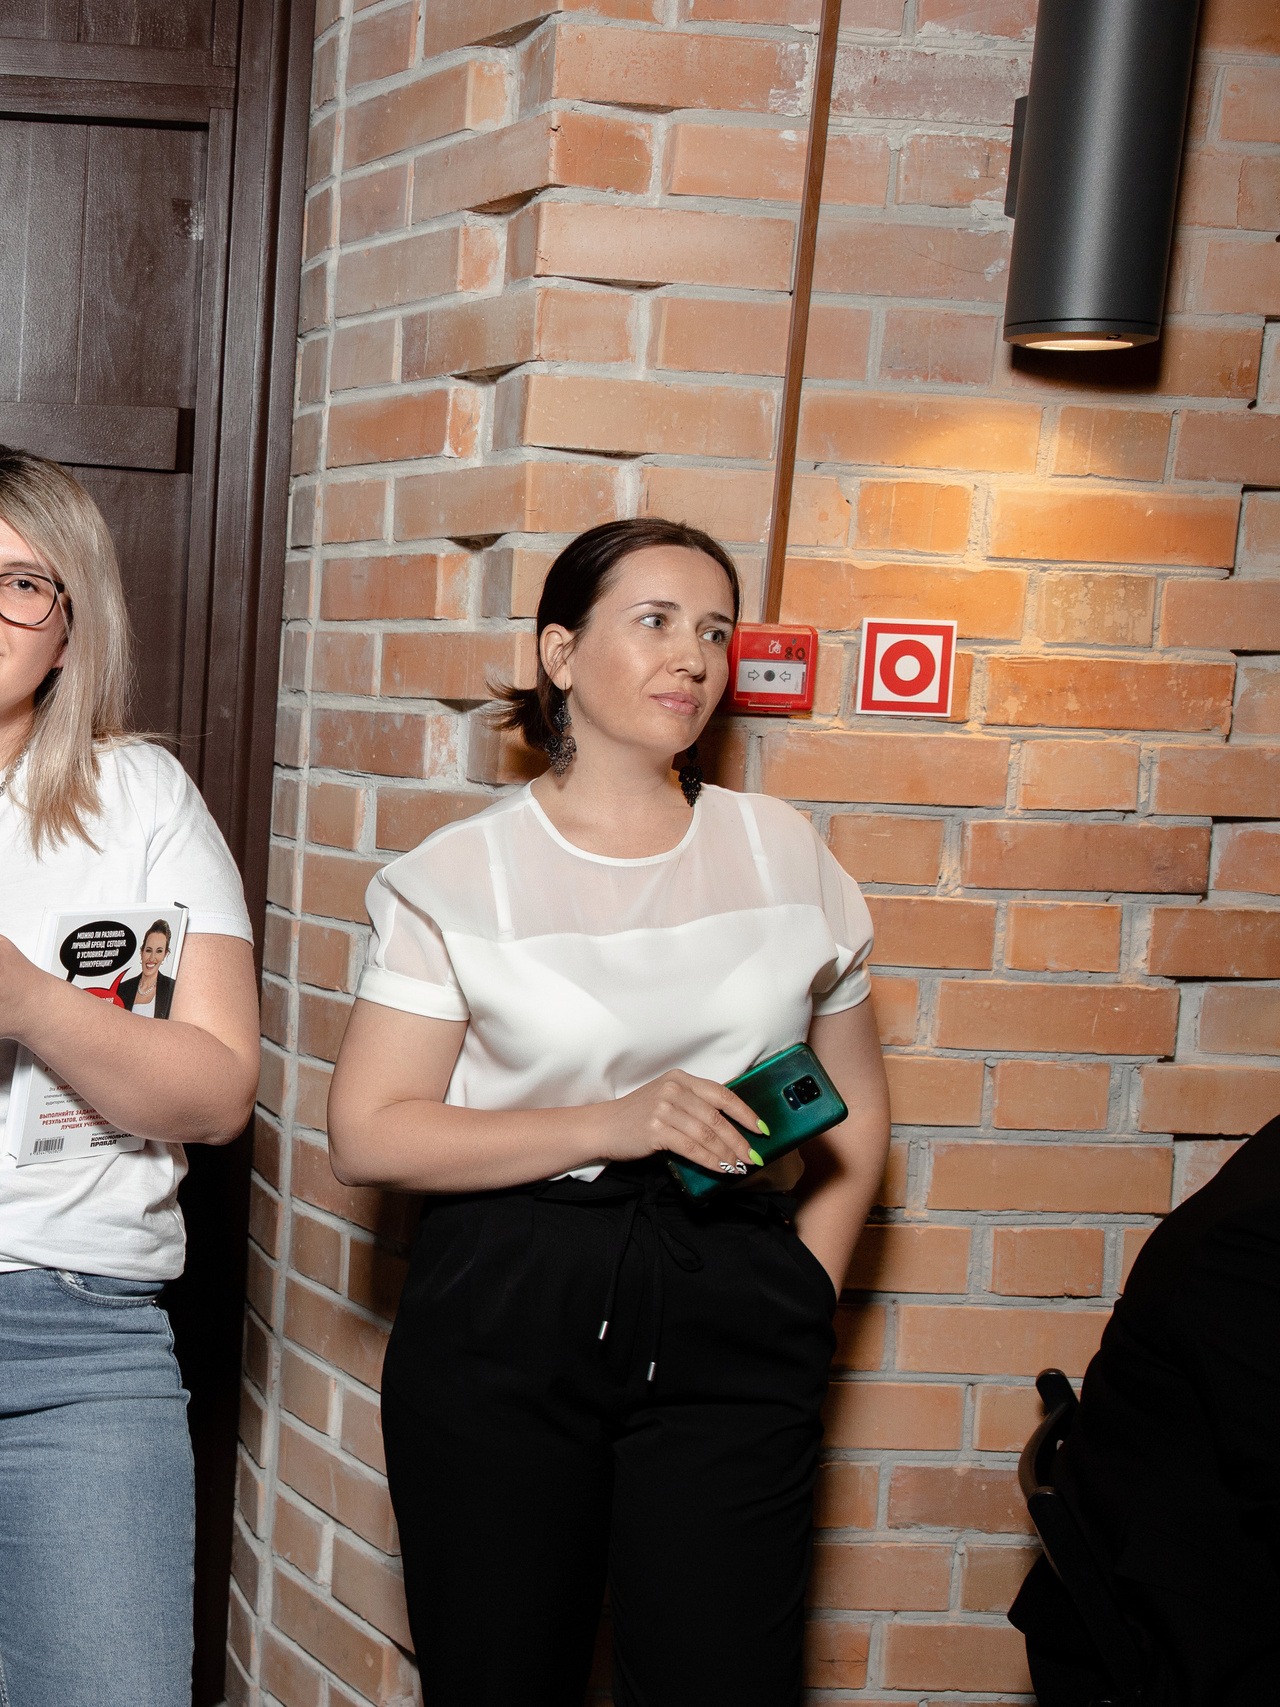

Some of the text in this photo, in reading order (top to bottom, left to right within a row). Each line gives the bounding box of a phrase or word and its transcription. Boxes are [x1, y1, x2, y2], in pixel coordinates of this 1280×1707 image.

[785, 646, 806, 661] 80
[91, 941, 106, 949] БРЕНД
[39, 1110, 75, 1119] ВЫПОЛНЯЙТЕ
